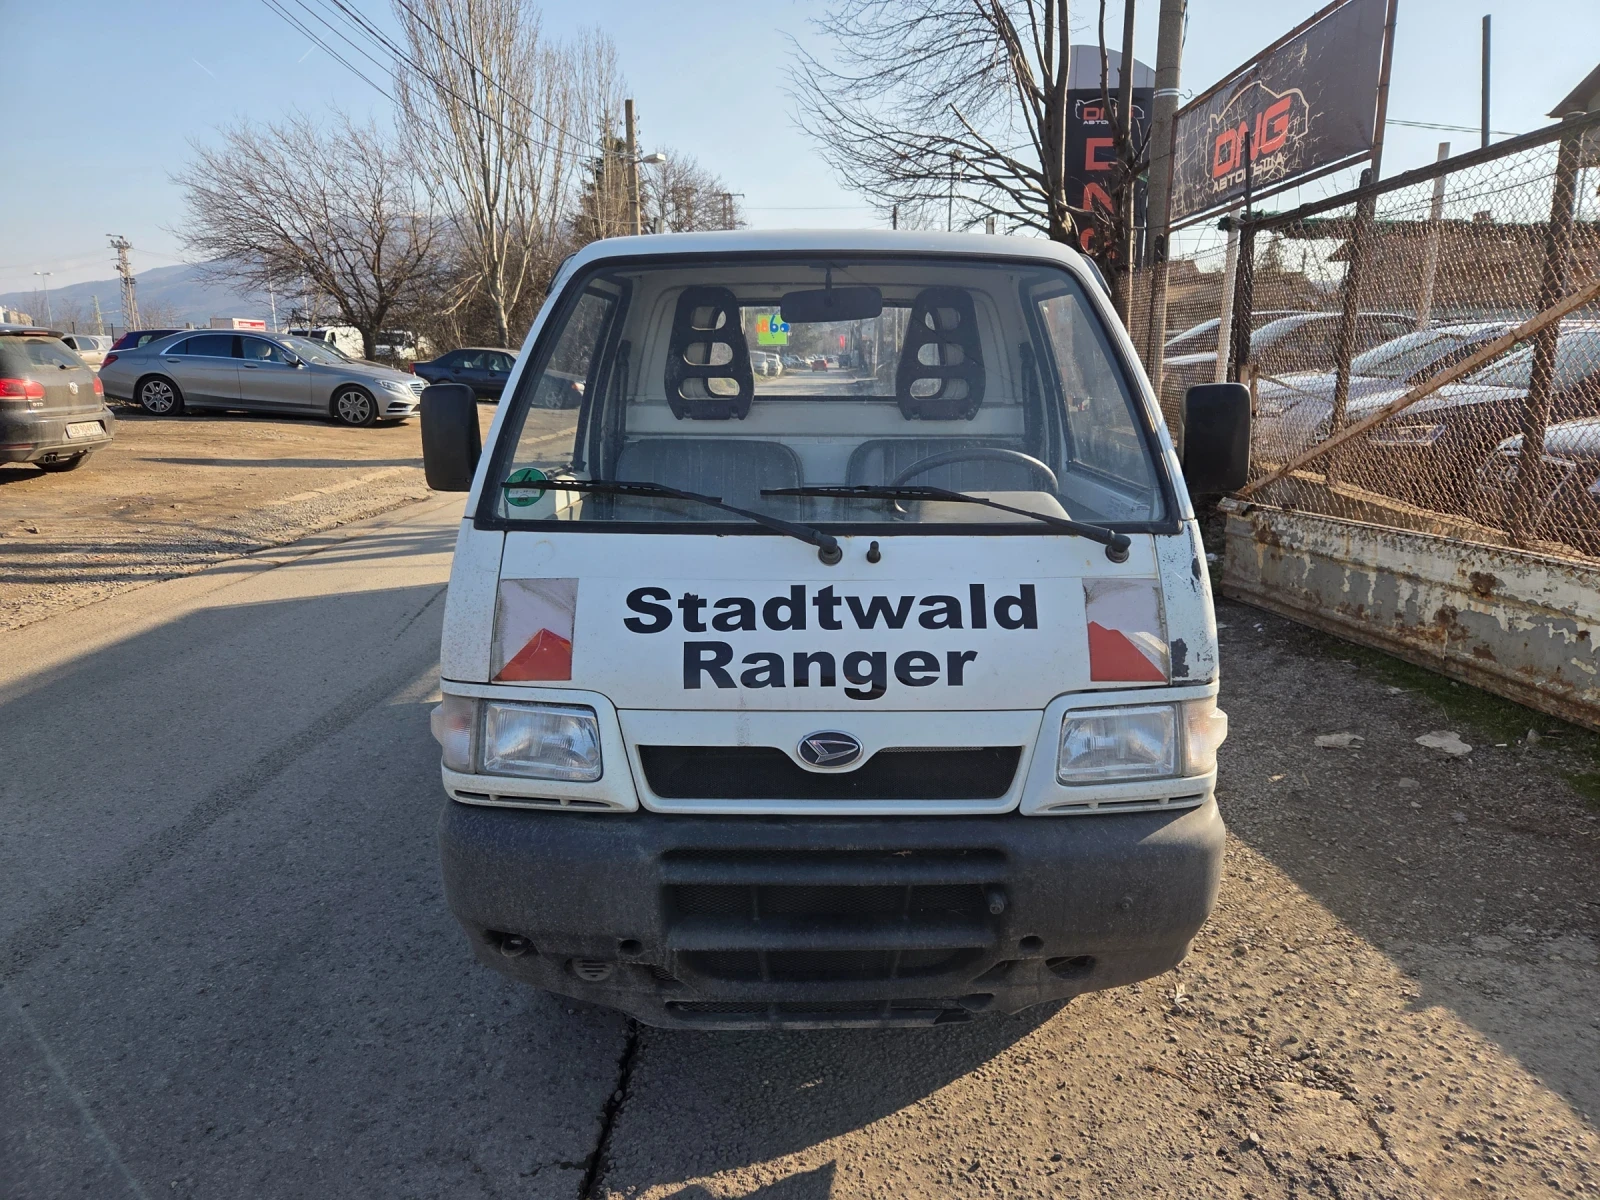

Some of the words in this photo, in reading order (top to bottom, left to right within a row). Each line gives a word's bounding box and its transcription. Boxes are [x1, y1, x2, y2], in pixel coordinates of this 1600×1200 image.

[1213, 96, 1291, 179] DNG
[623, 584, 1038, 633] Stadtwald
[683, 640, 978, 700] Ranger
